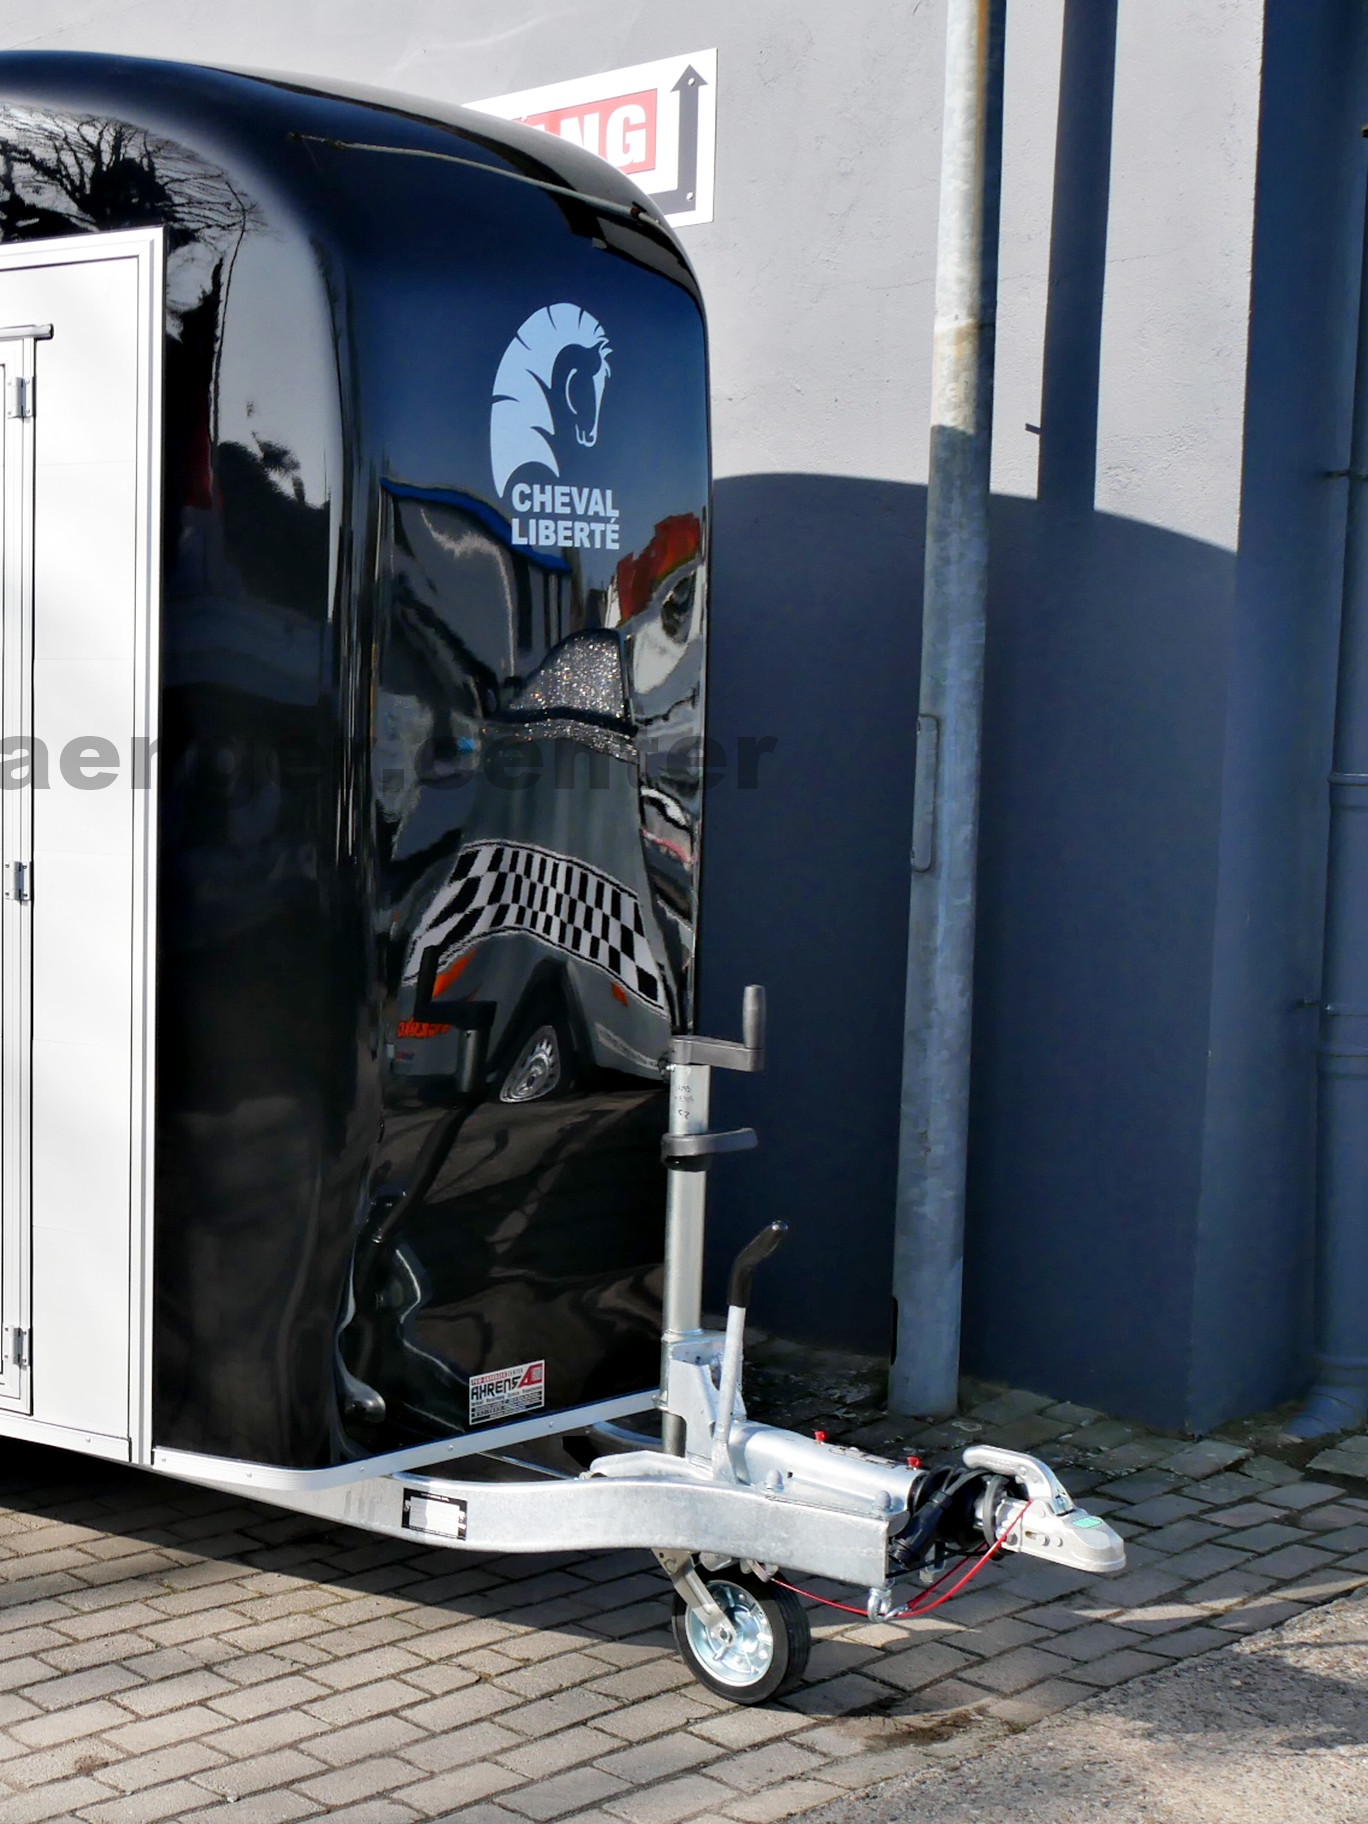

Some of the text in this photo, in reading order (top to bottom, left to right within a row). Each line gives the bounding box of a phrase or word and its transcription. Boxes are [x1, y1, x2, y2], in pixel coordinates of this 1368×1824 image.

[512, 482, 620, 518] CHEVAL
[511, 517, 620, 550] LIBERTÉ
[471, 1375, 522, 1401] AHRENS
